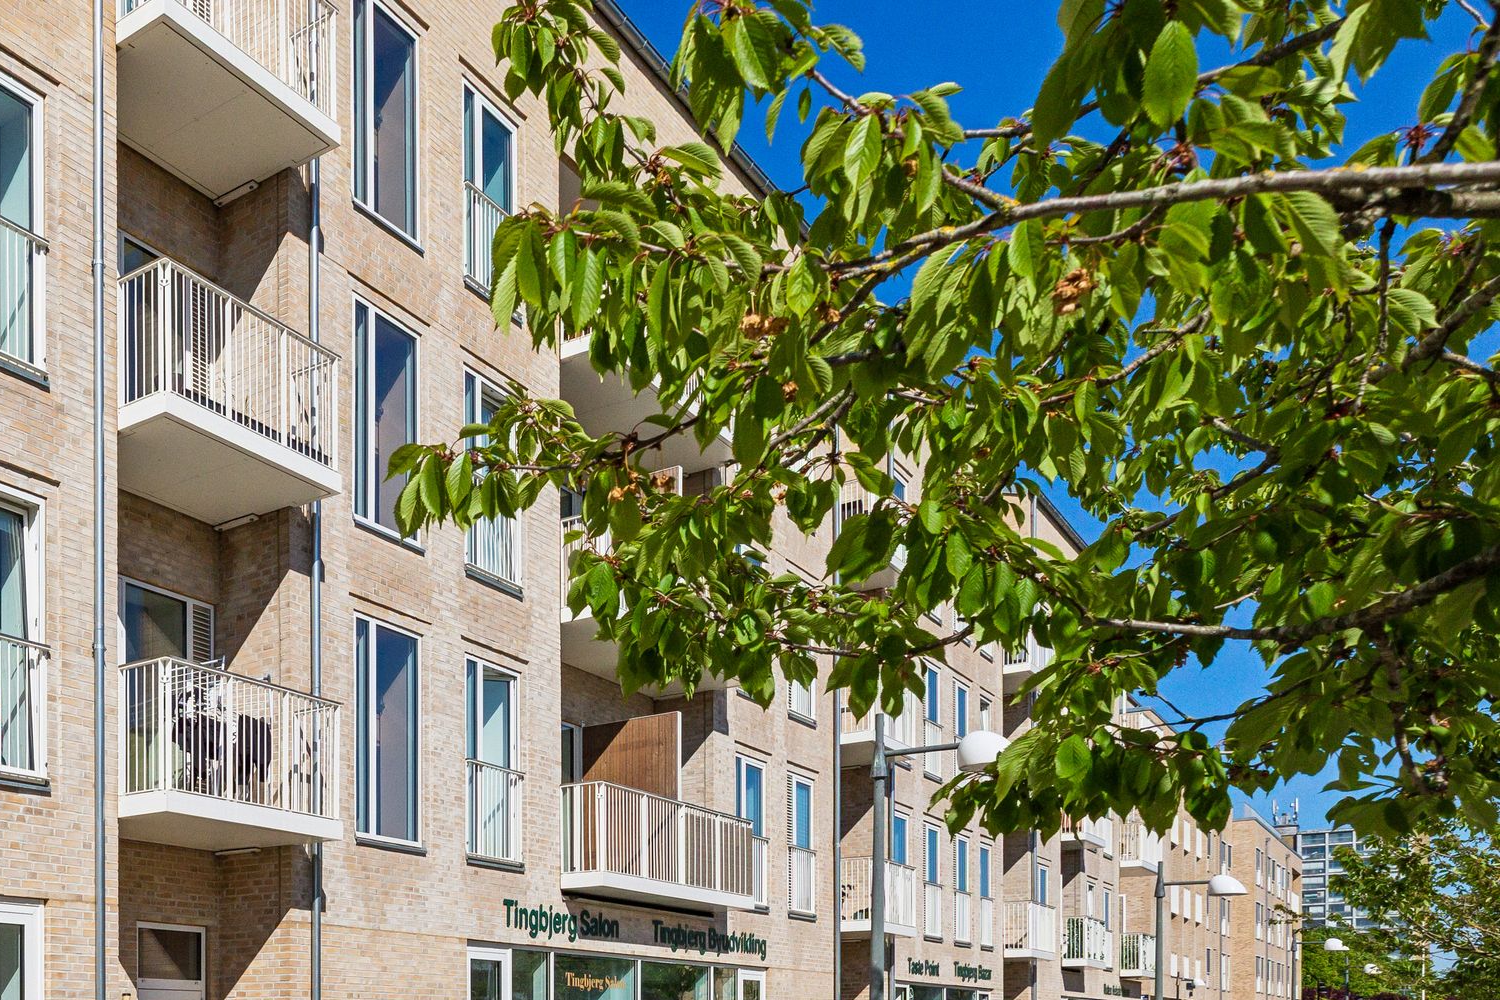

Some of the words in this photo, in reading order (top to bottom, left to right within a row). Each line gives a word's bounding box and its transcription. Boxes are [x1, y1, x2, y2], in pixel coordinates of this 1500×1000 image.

[503, 899, 578, 942] Tingbjerg
[580, 910, 619, 938] Salon
[652, 920, 706, 955] Tingbjerg
[708, 927, 767, 961] Byudvikling
[907, 957, 923, 975] Taste
[925, 960, 939, 977] Point
[953, 961, 977, 983] Tingbjerg
[565, 971, 604, 992] Tingbjerg
